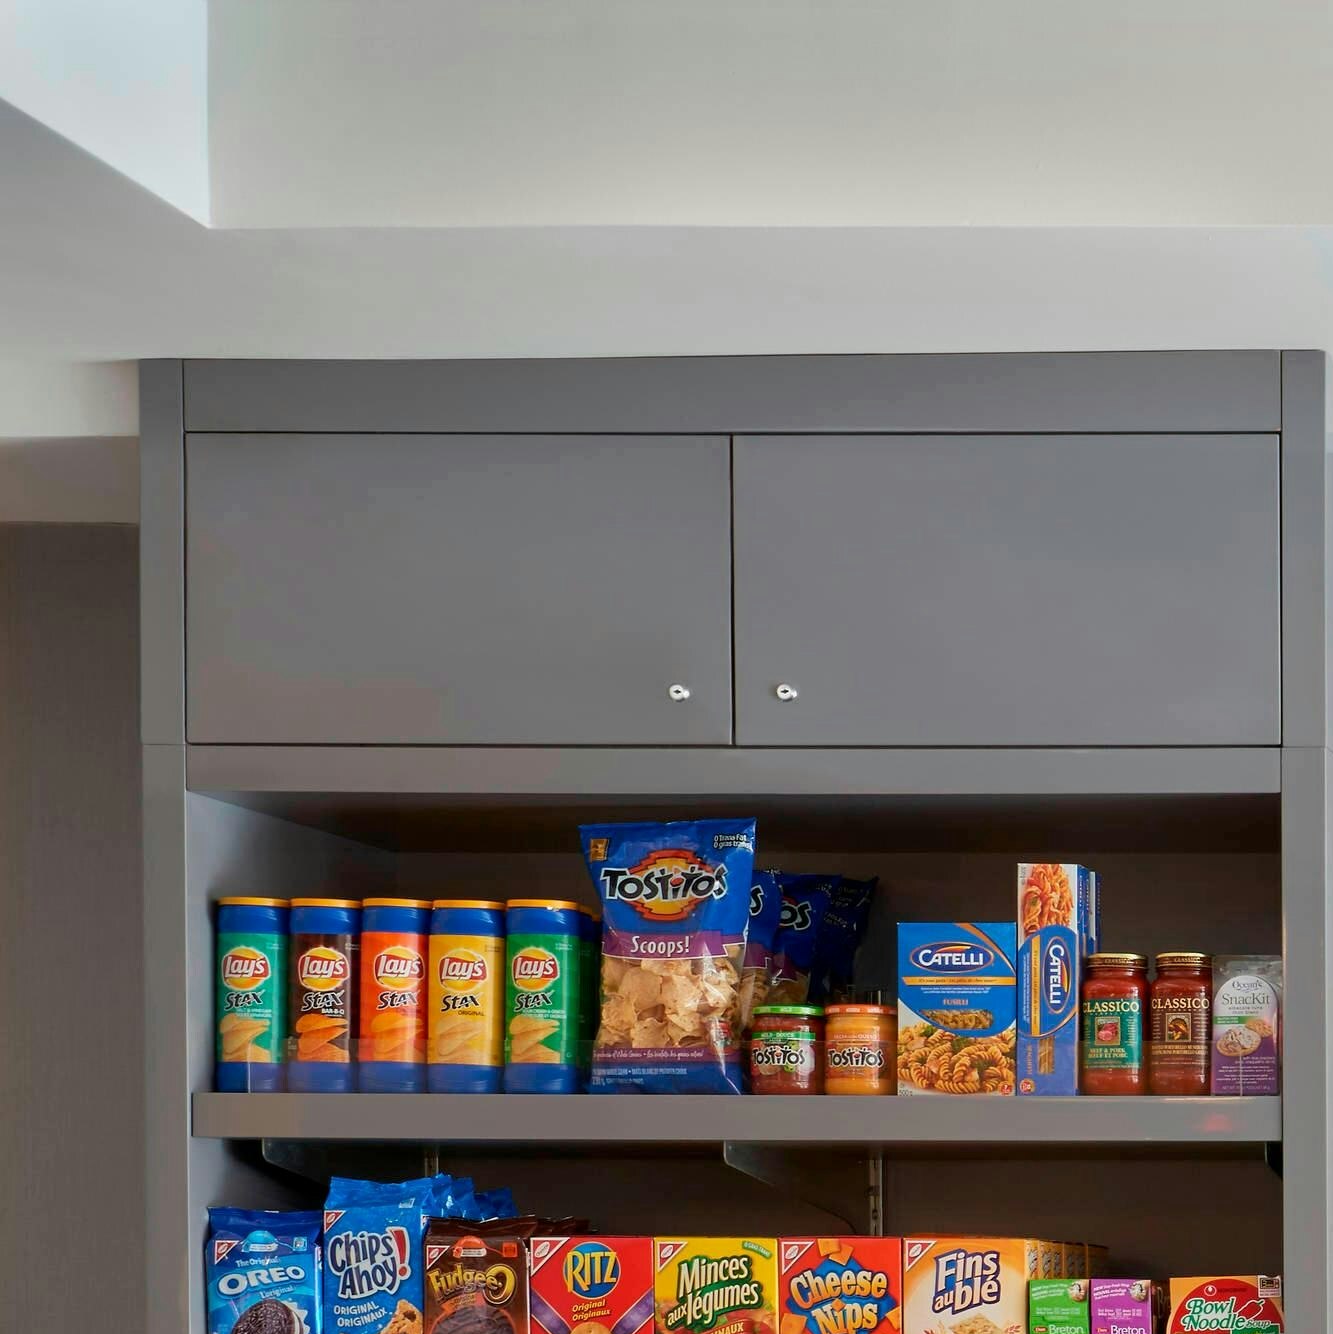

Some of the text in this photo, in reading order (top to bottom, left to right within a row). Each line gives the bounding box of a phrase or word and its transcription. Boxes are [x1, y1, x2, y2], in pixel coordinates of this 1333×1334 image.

[631, 935, 690, 956] Scoops!
[917, 945, 984, 966] CATELLI
[225, 955, 267, 977] Lay's
[301, 955, 346, 978] Lay's
[377, 954, 421, 978] Lay's
[442, 957, 485, 980] Lay's
[515, 956, 557, 979] Lay's
[1048, 945, 1063, 1004] CATELLI
[1083, 999, 1139, 1014] CLASSICO
[1152, 996, 1209, 1010] CLASSICO
[1222, 992, 1270, 1006] SnacKit
[236, 1259, 249, 1267] The
[330, 1231, 392, 1274] Chips
[220, 1265, 305, 1294] OREO
[565, 1251, 617, 1292] RITZ
[679, 1257, 748, 1298] Minces
[936, 1251, 998, 1292] Fins
[791, 1270, 888, 1308] Cheese
[935, 1275, 998, 1312] au blé
[334, 1301, 379, 1315] ORIGINAL
[572, 1300, 605, 1313] Original
[668, 1283, 759, 1325] aux légumes
[1186, 1297, 1236, 1315] Bowl
[337, 1309, 387, 1327] ORIGINAUX
[572, 1310, 610, 1322] Originaux
[1181, 1314, 1271, 1331] Noodle Soup
[1049, 1324, 1084, 1334] Breton
